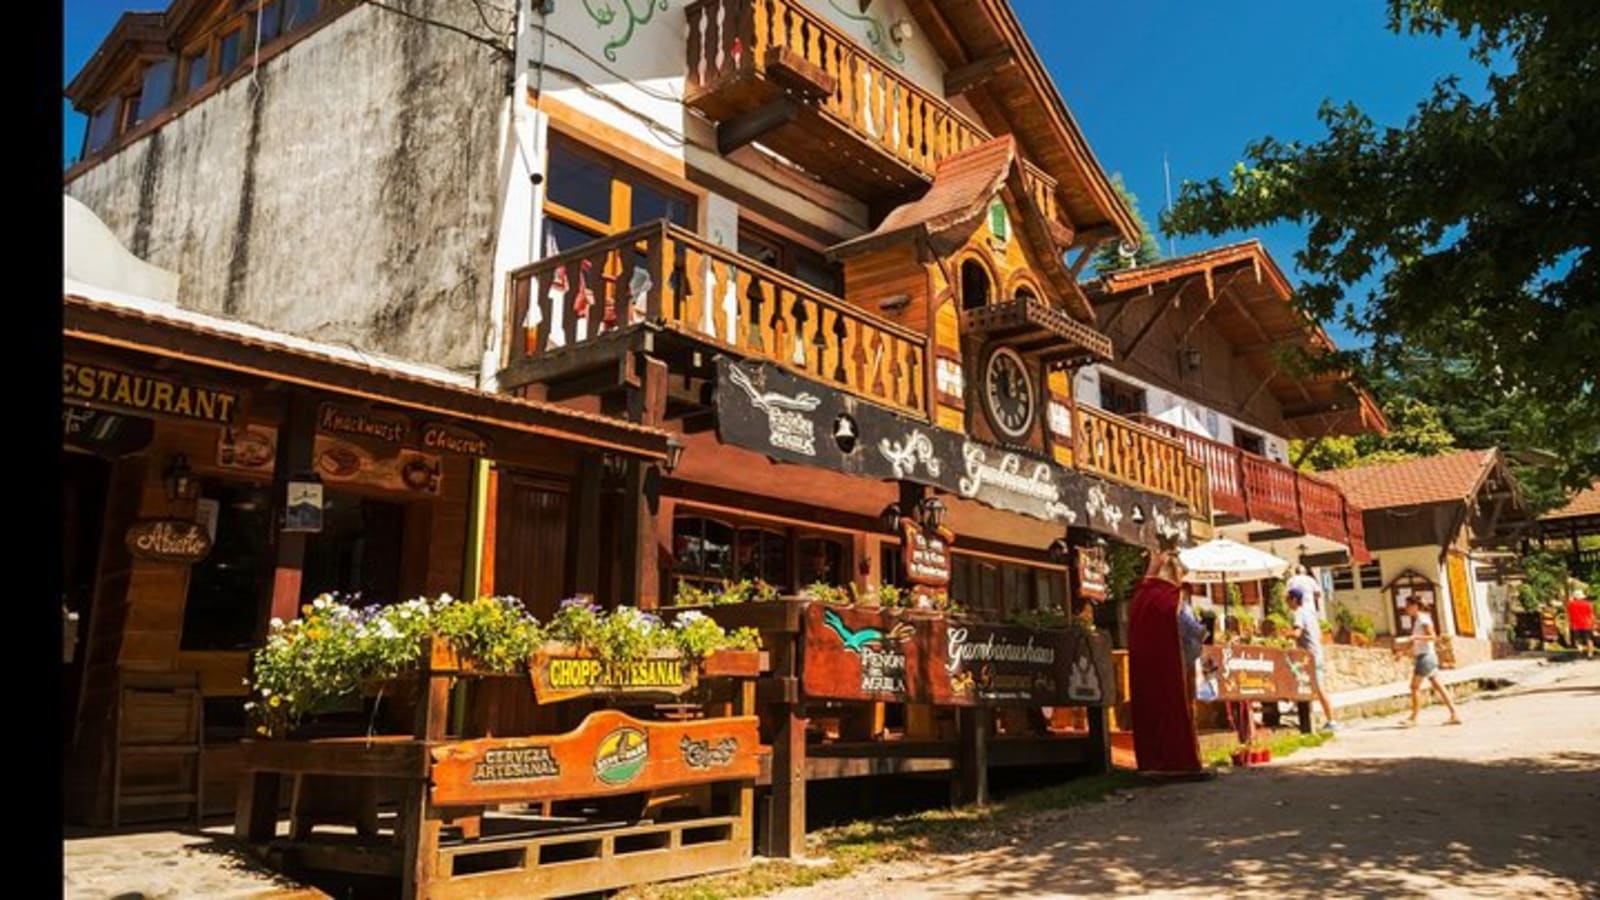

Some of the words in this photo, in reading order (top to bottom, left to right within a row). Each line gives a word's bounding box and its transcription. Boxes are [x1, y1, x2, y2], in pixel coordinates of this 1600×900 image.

[550, 658, 600, 686] CHOPP
[603, 660, 683, 686] ARTESANAL
[486, 748, 550, 764] CERVEZA
[475, 761, 558, 779] ARTESANAL
